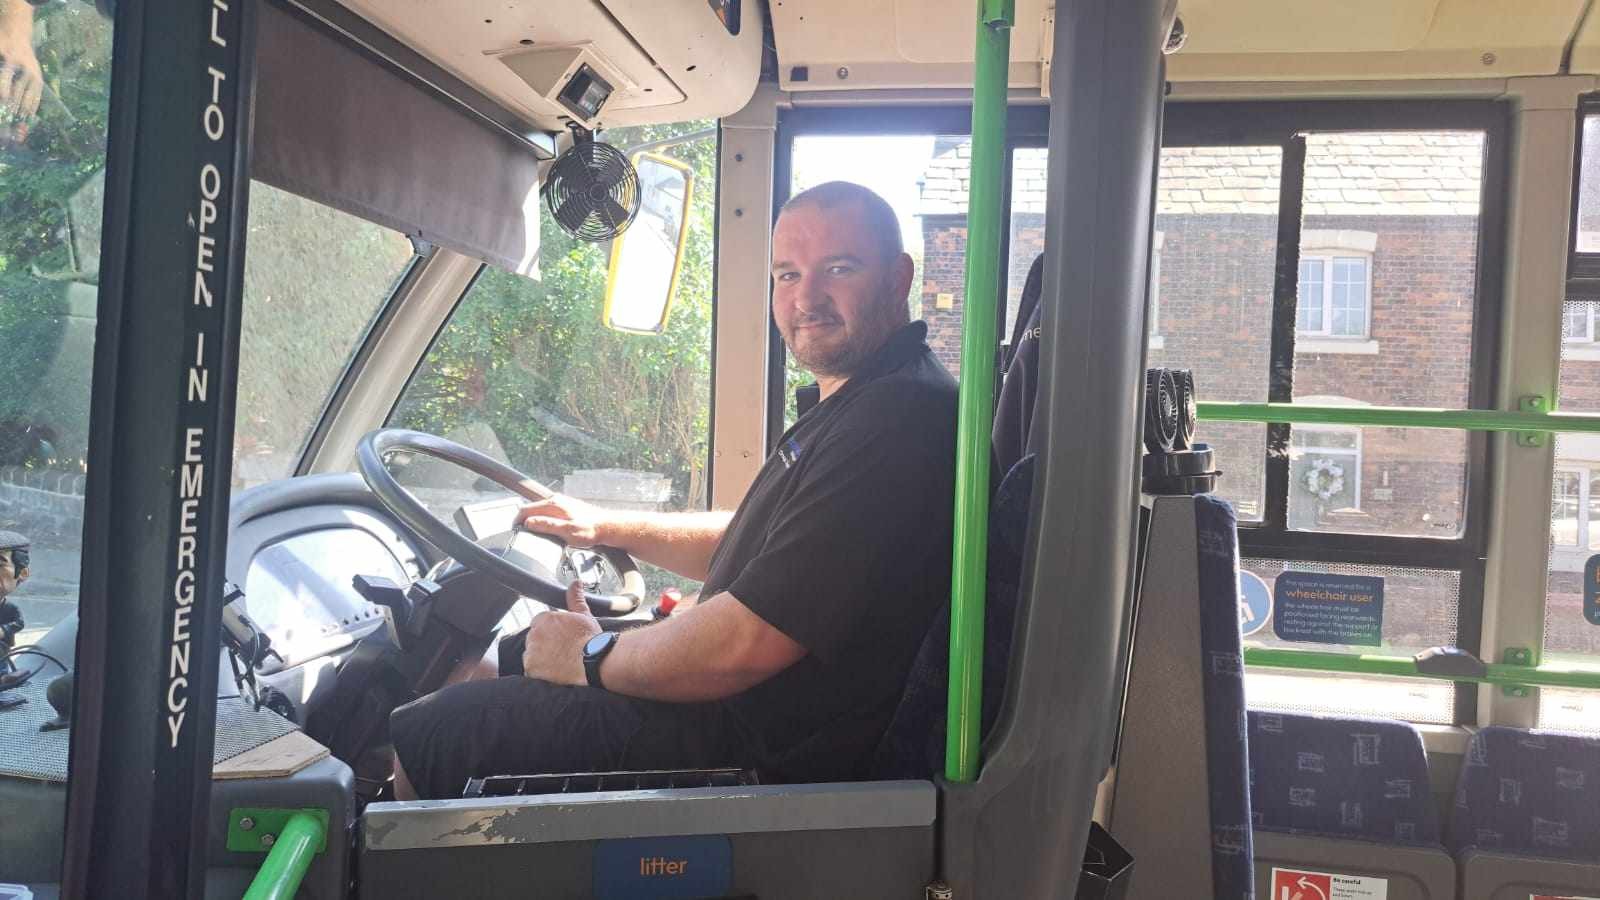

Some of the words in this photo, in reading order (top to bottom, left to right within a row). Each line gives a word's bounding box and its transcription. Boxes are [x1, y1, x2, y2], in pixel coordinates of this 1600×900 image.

[203, 66, 226, 141] TO
[194, 163, 221, 307] OPEN
[187, 332, 208, 402] IN
[167, 428, 204, 748] EMERGENCY
[1286, 588, 1346, 601] wheelchair
[1349, 593, 1375, 603] user
[640, 857, 688, 876] litter
